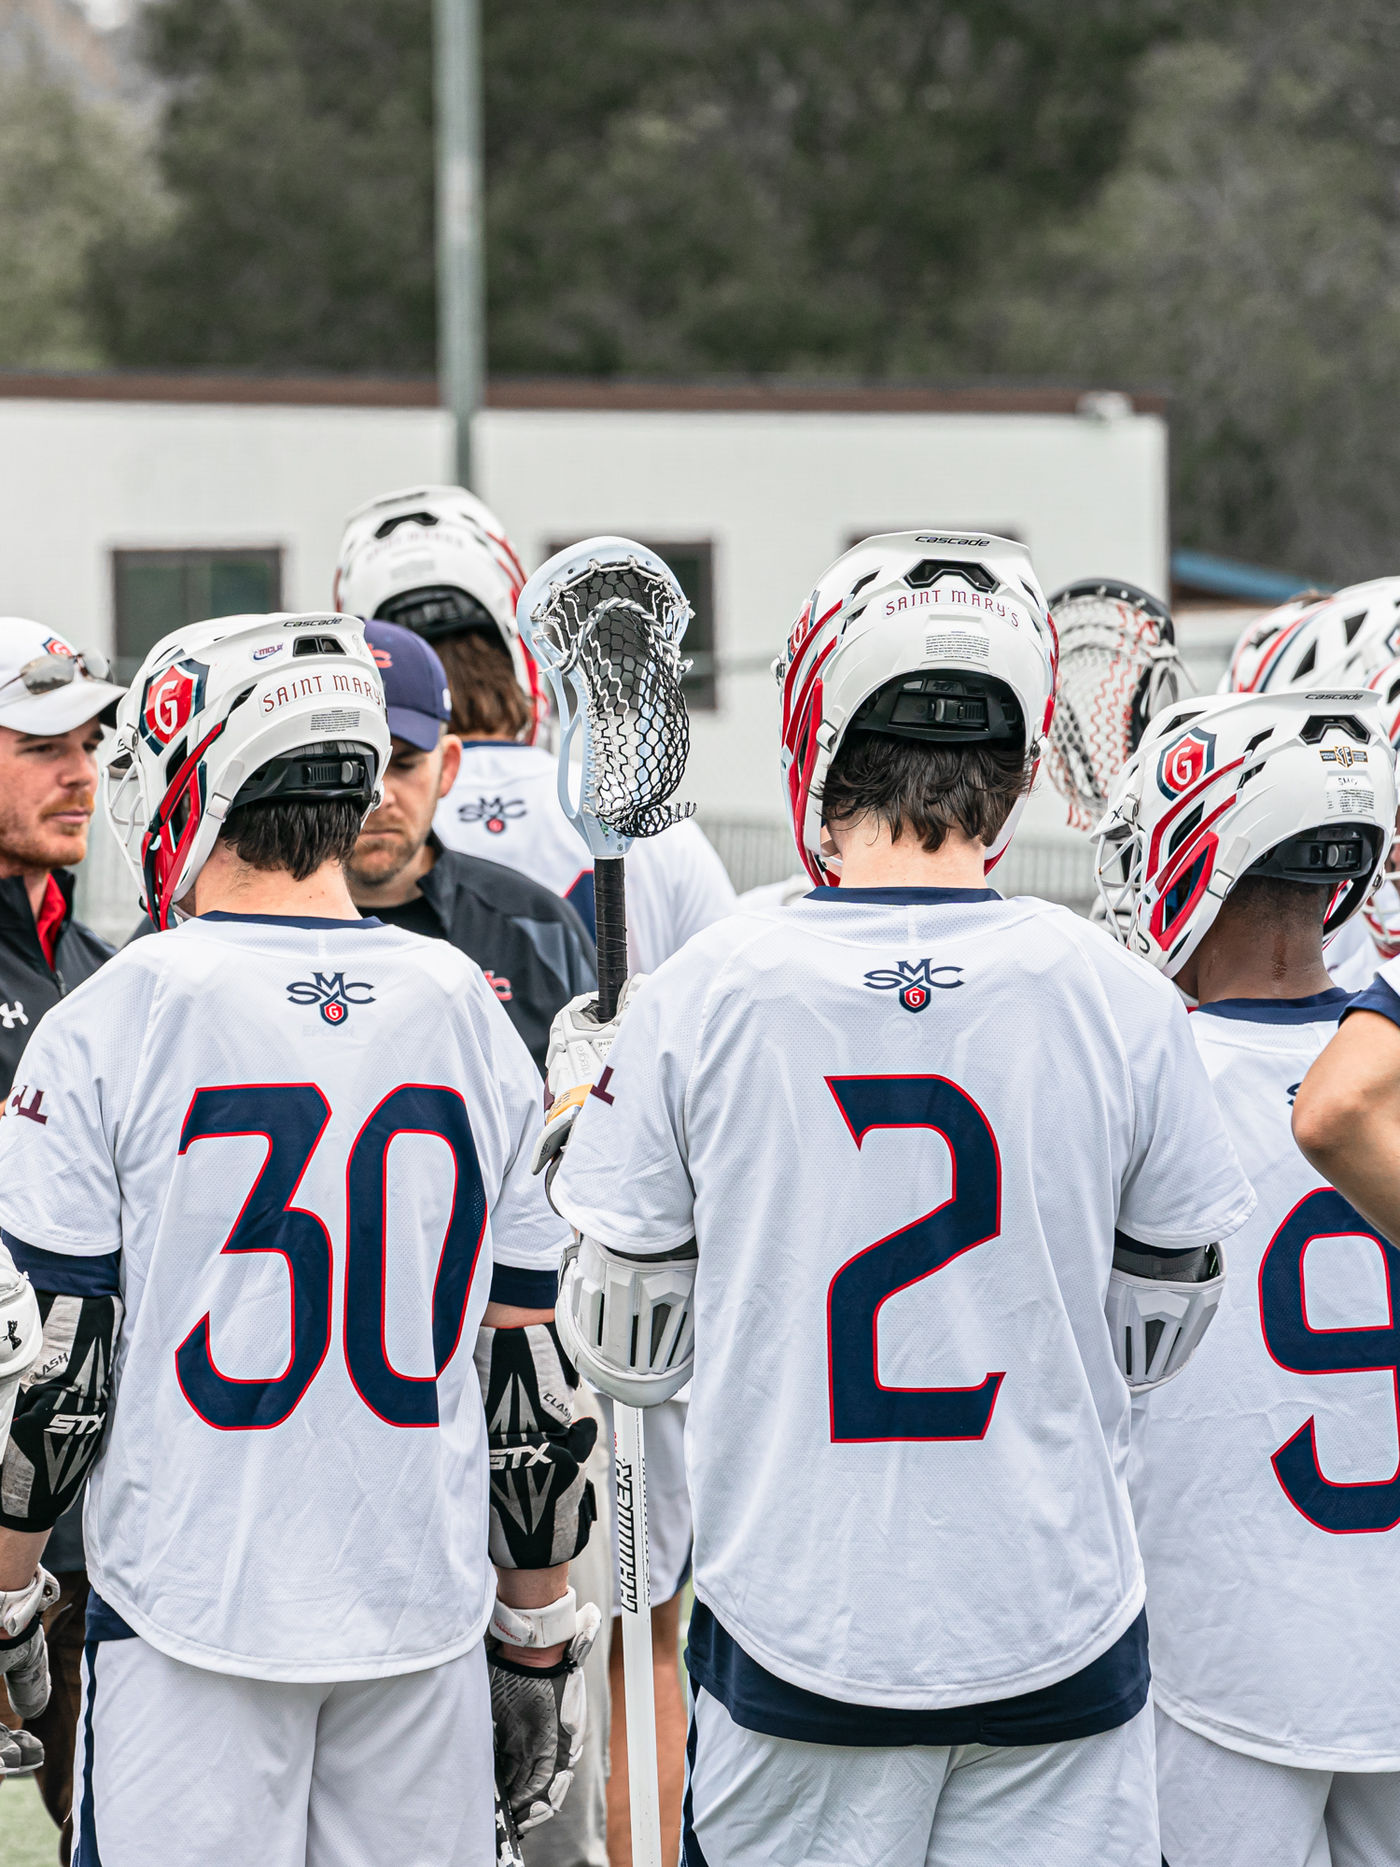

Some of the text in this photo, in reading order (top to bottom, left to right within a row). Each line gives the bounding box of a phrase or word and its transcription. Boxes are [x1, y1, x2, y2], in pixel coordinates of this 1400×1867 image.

[915, 536, 990, 547] cascade
[283, 617, 342, 628] cascade
[886, 589, 1019, 628] SAINT MARY'S
[154, 680, 178, 734] G
[263, 676, 322, 713] SAINT
[1305, 693, 1363, 701] cascade
[1171, 745, 1192, 785] G
[286, 972, 376, 1005] SMC
[863, 958, 964, 990] SMC
[329, 1006, 339, 1019] G
[909, 991, 920, 1005] G
[175, 1082, 487, 1431] 30
[823, 1073, 1007, 1444] 2
[1258, 1186, 1400, 1535] 9
[43, 1411, 107, 1435] STX
[489, 1442, 552, 1470] STX
